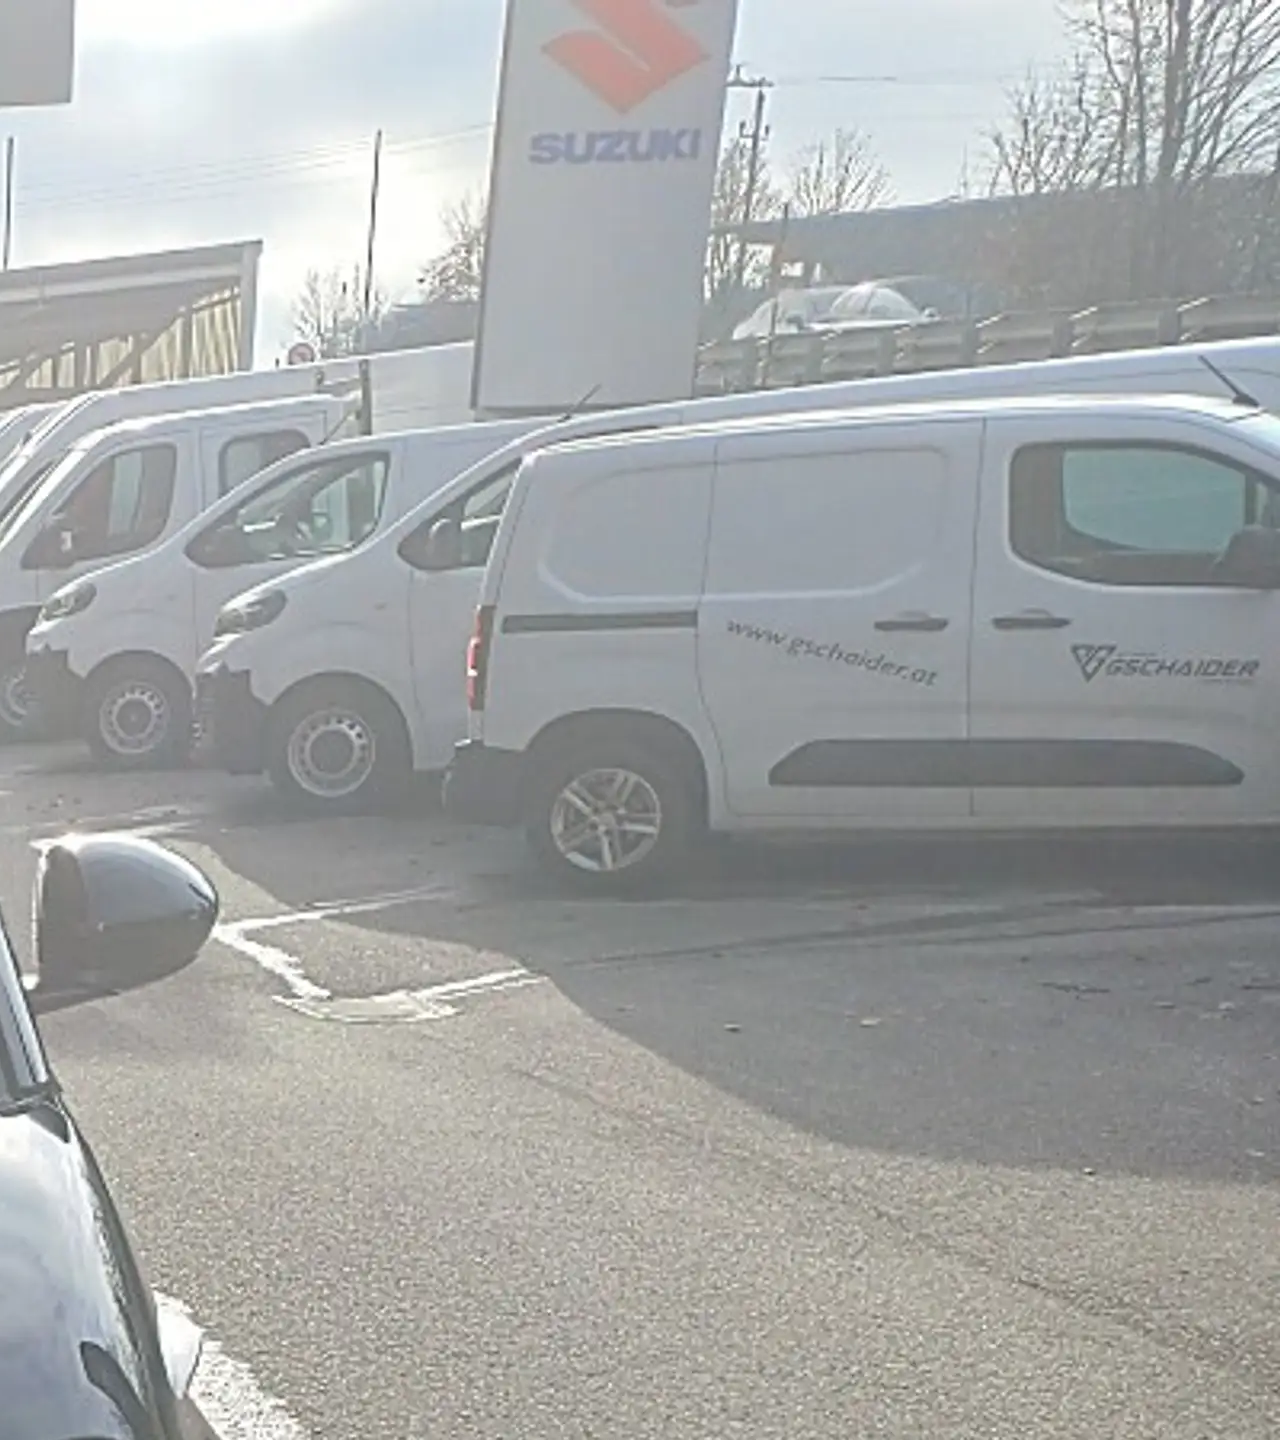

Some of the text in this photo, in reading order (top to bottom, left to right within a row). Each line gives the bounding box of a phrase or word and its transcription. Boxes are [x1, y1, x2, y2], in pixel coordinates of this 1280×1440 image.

[528, 129, 702, 164] SUZUKI
[726, 620, 938, 687] www.gschaider.at
[1104, 658, 1261, 677] GSCHAIDER
